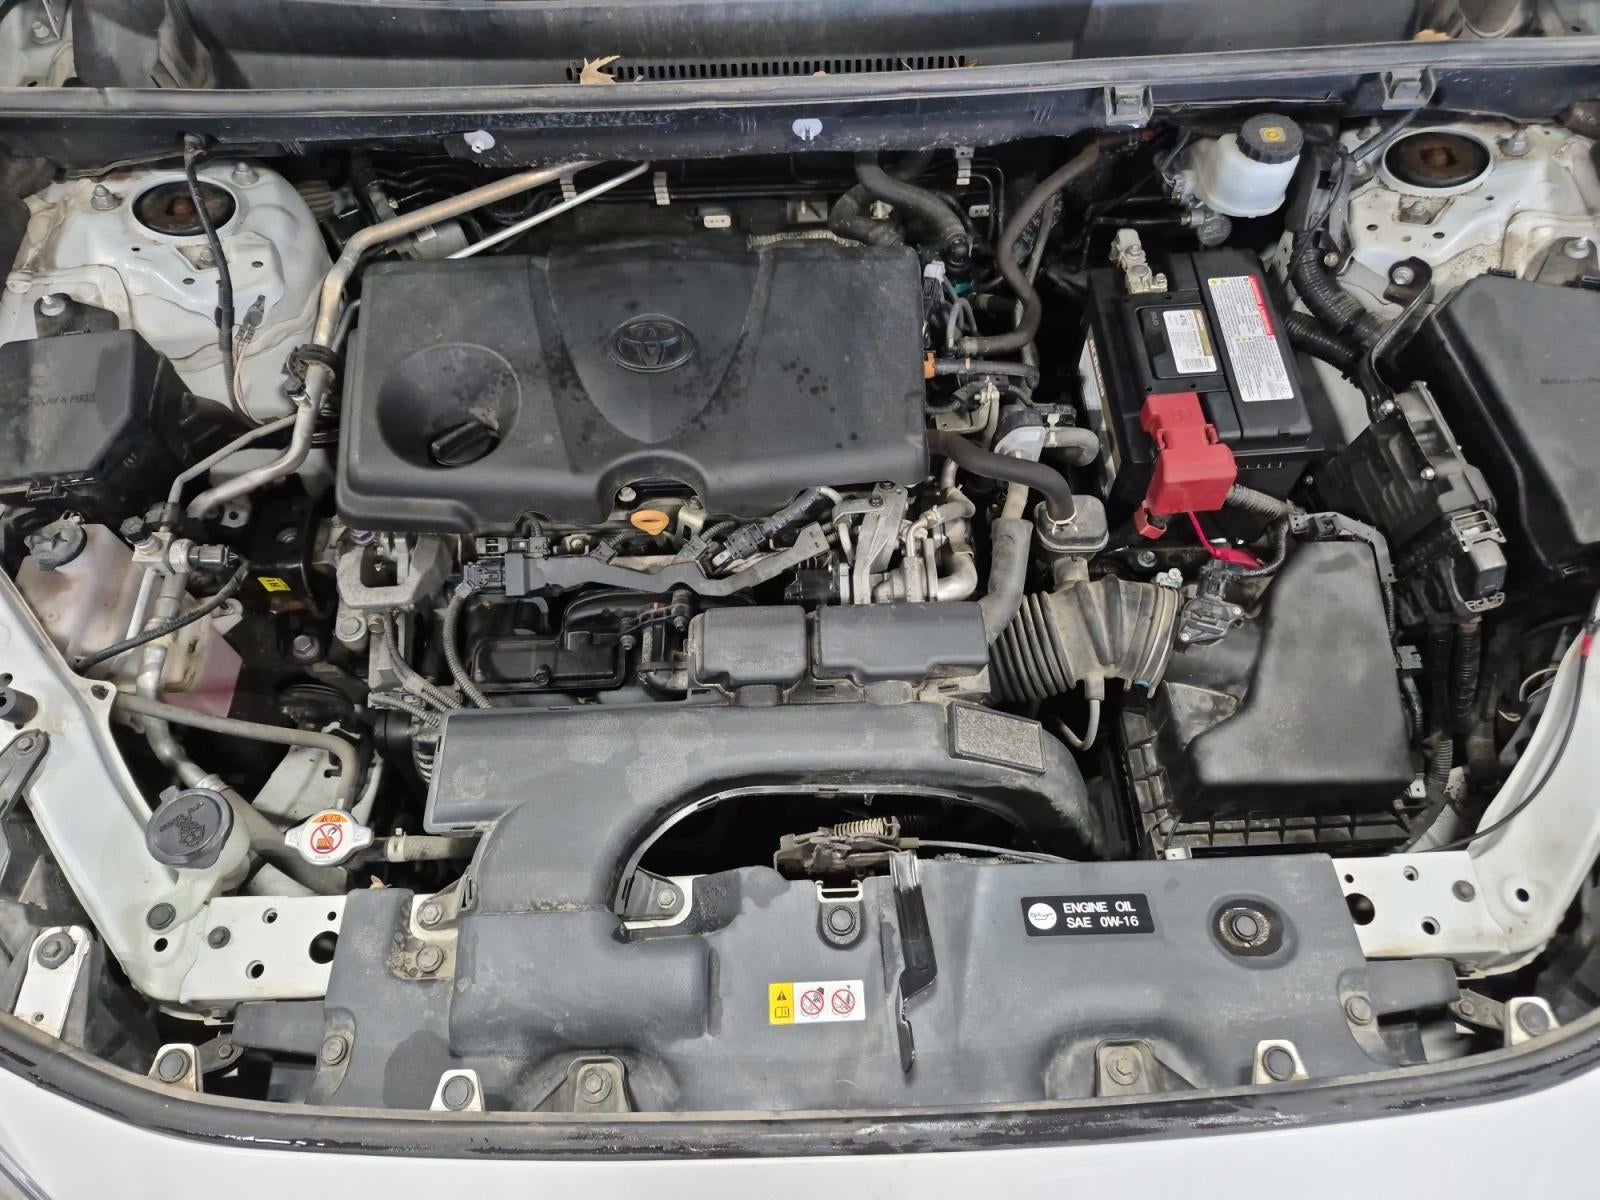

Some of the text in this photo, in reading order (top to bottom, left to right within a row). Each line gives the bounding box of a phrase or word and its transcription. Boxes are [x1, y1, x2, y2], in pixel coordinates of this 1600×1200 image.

[1063, 901, 1136, 913] ENGINE OIL
[1066, 915, 1139, 928] SAE 0W-16
